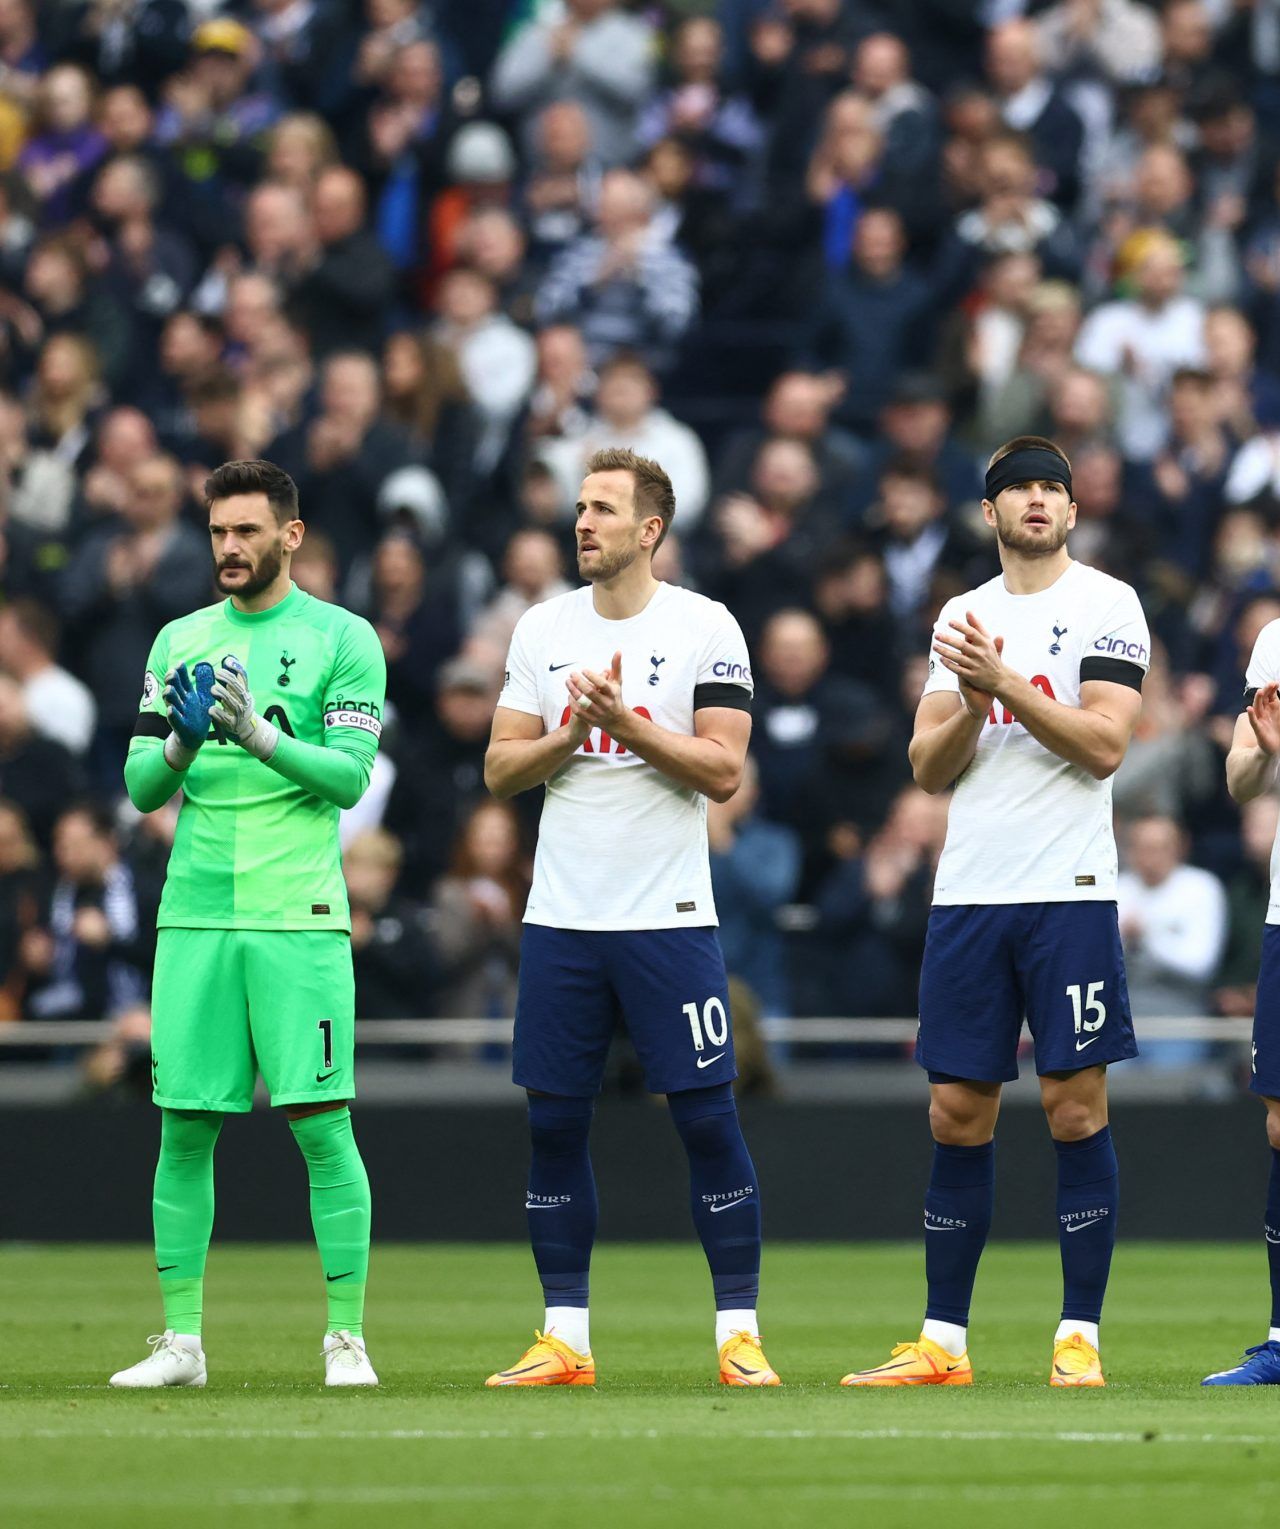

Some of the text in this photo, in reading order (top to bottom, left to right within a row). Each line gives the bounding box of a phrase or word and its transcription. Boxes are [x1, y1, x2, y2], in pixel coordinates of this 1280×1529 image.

[1093, 634, 1148, 661] cinch
[1066, 980, 1106, 1034] 15
[682, 996, 728, 1052] 10
[318, 1019, 332, 1069] 1
[526, 1191, 571, 1204] SPURS
[702, 1185, 753, 1204] SPURS
[1060, 1207, 1109, 1223] SPURS
